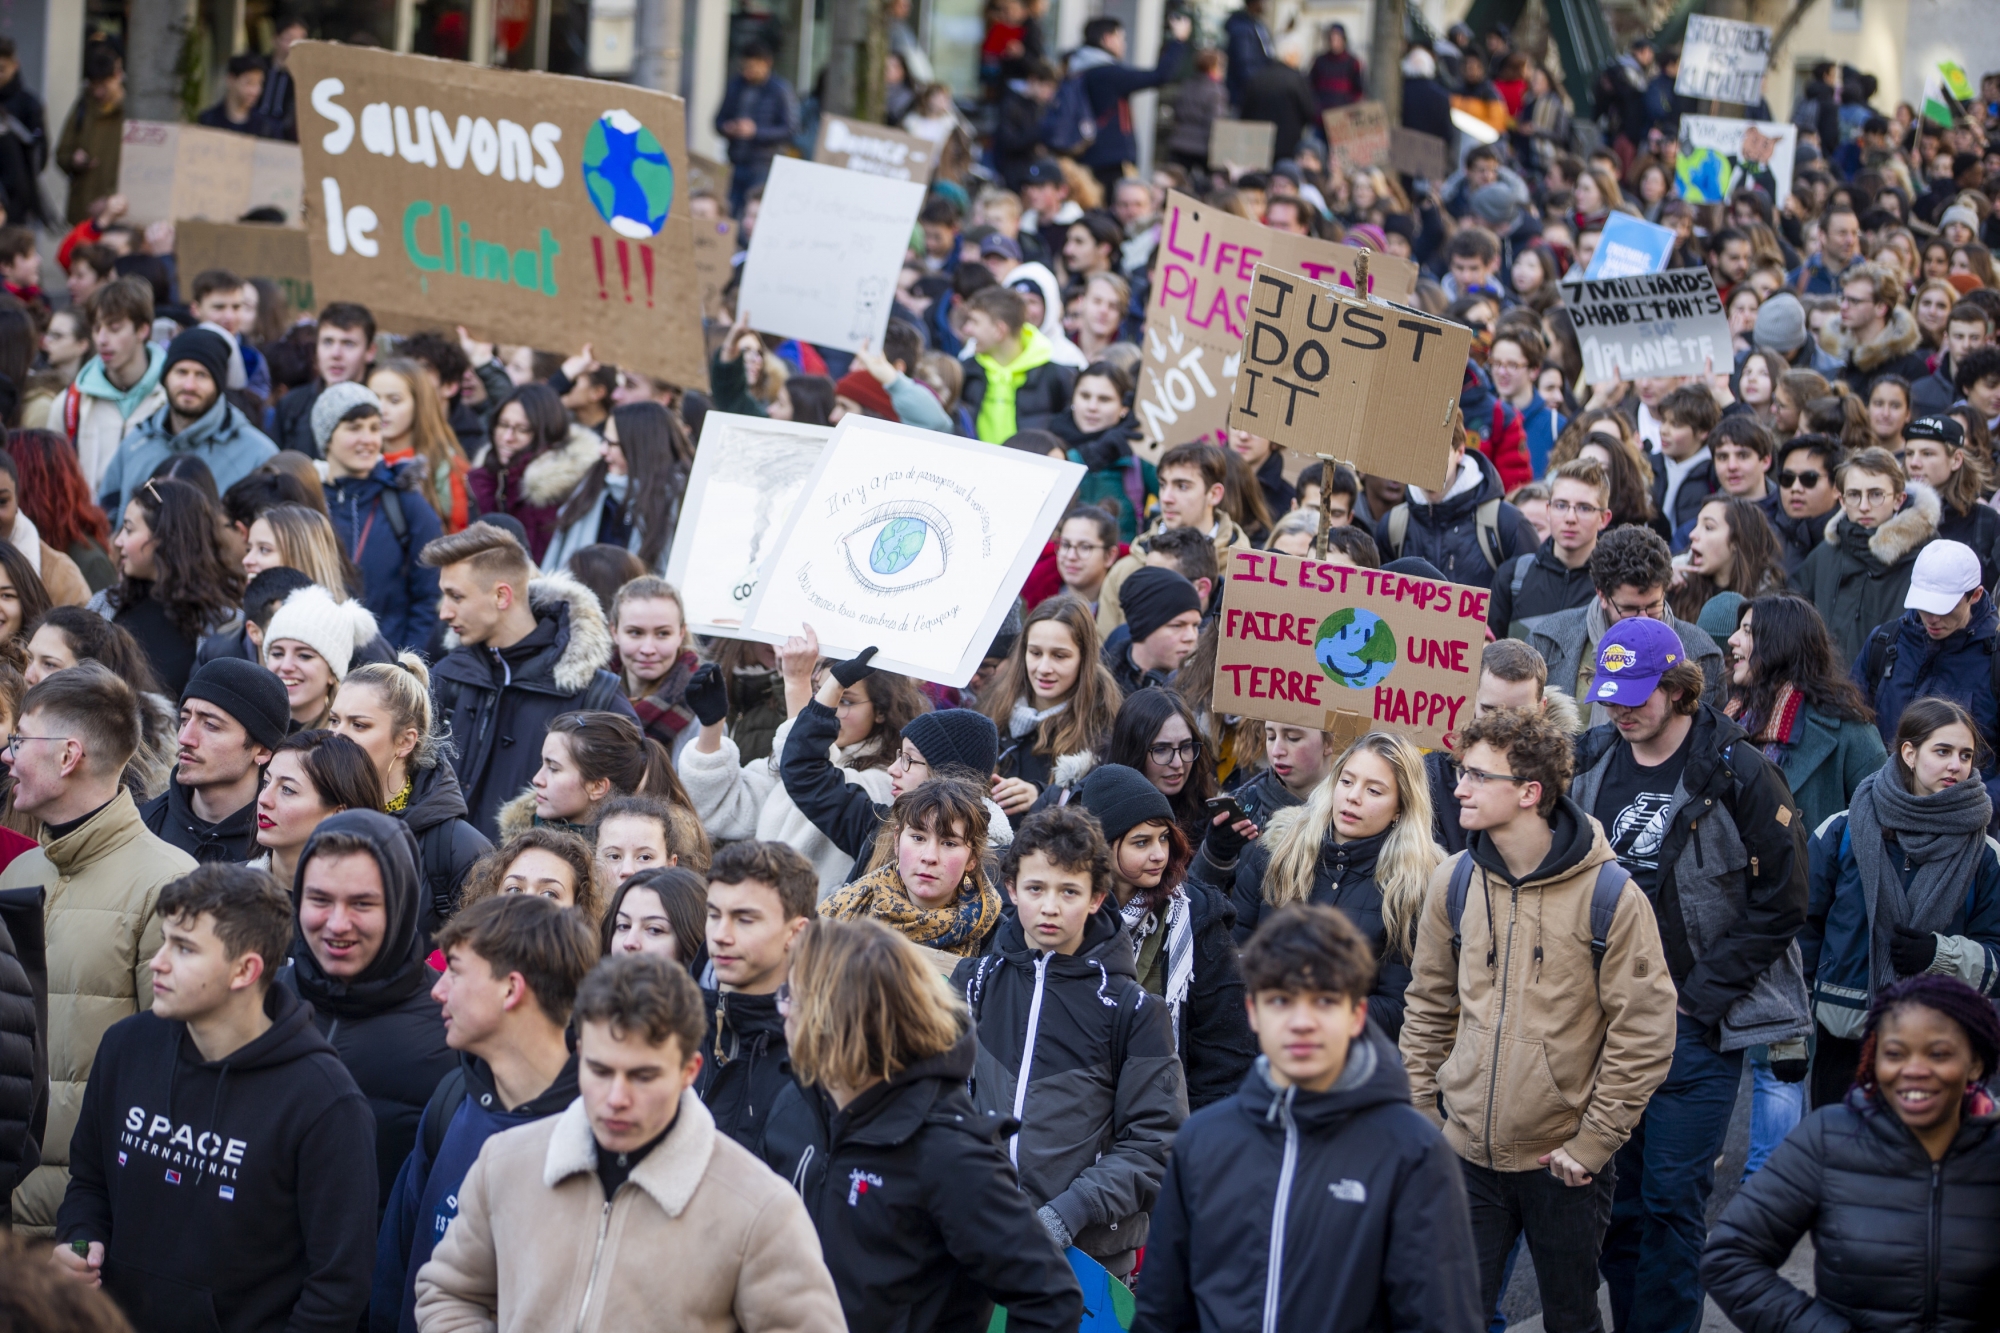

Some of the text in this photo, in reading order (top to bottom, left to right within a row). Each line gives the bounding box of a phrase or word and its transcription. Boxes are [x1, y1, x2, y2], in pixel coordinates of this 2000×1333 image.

[311, 77, 565, 189] Sauvons
[322, 177, 379, 257] le
[403, 200, 561, 297] Climat
[1167, 206, 1264, 281] LIFE
[1255, 274, 1442, 363] JUST
[1562, 283, 1583, 304] 7
[1251, 321, 1330, 382] DO
[1141, 347, 1217, 442] NOT
[1239, 368, 1320, 427] IT
[882, 471, 903, 491] pas
[905, 465, 916, 479] de
[733, 580, 759, 601] CO
[837, 600, 856, 619] tous
[897, 612, 909, 631] de
[1232, 553, 1489, 622] IL EST TEMPS DE
[1226, 608, 1469, 673] FAIRE UNE
[1221, 664, 1466, 731] TERRE HAPPY
[120, 1130, 238, 1181] INTERNATIONAL
[125, 1106, 247, 1166] SPACE
